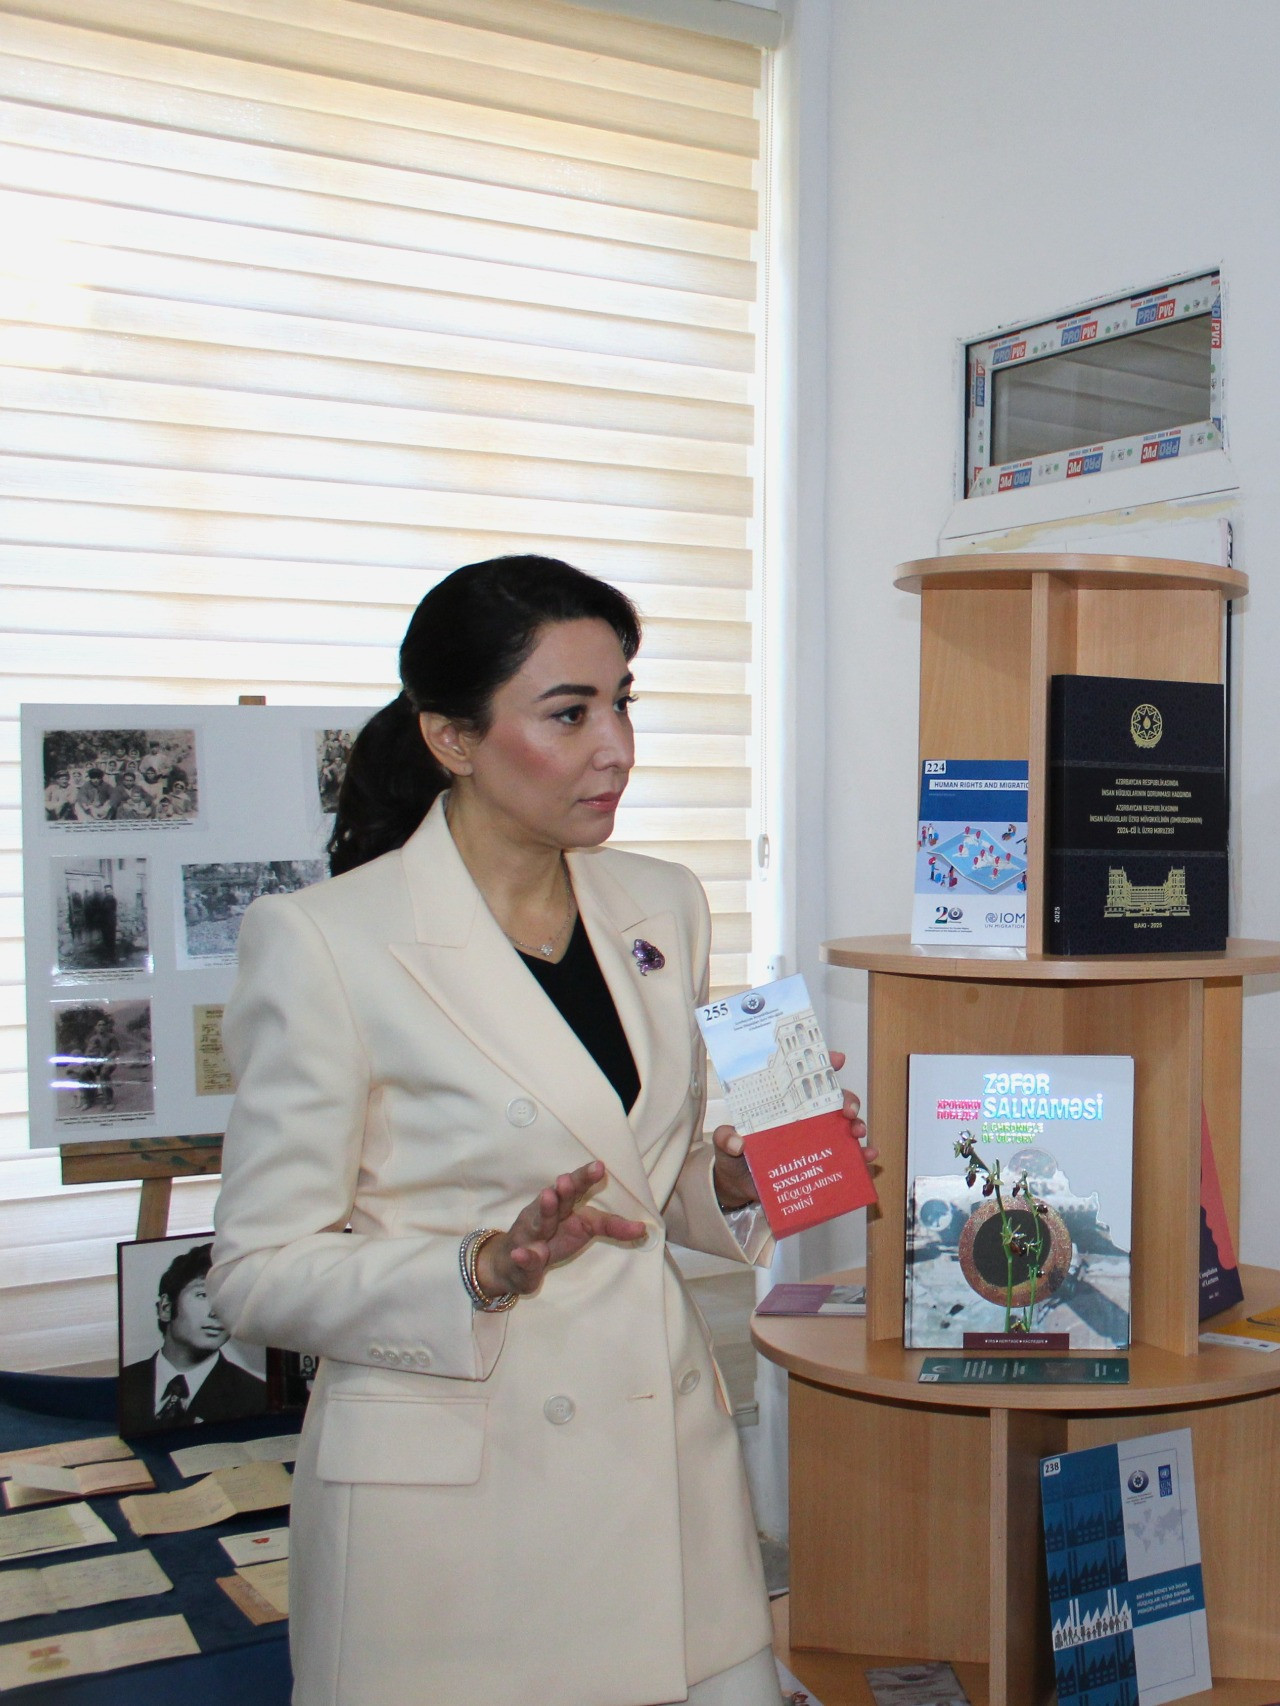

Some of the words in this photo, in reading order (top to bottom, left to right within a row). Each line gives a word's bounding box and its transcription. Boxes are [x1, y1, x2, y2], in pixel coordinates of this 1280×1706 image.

[1159, 303, 1173, 318] PVC
[1082, 325, 1097, 340] PVC
[1212, 323, 1220, 346] PVC
[1012, 344, 1025, 359] PVC
[1142, 445, 1158, 461] PVC
[1068, 460, 1082, 475] PVC
[1000, 475, 1013, 488] PVC
[927, 763, 945, 772] 224
[1000, 913, 1025, 923] IOM
[704, 1003, 729, 1022] 255
[983, 1073, 1050, 1095] ZƏFƏR
[983, 1094, 1103, 1120] SALNAMƏSİ
[807, 1148, 833, 1163] OLAN
[781, 1195, 814, 1215] TƏMİNİ
[1045, 1462, 1059, 1473] 238
